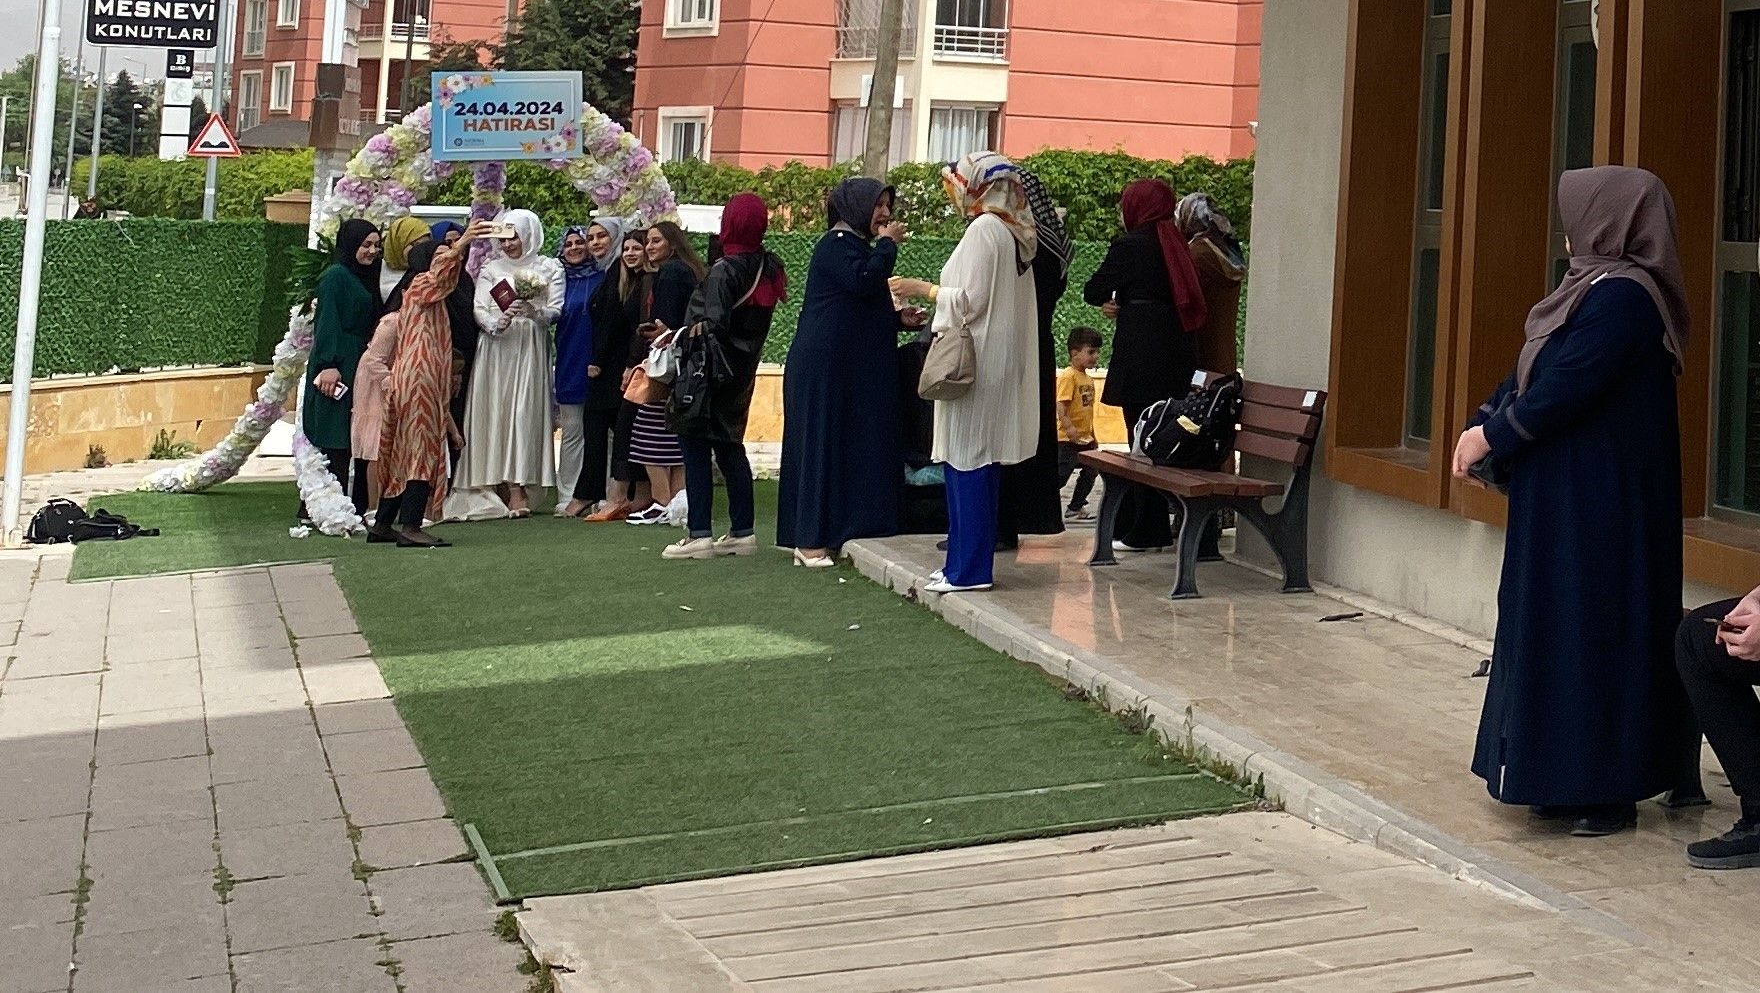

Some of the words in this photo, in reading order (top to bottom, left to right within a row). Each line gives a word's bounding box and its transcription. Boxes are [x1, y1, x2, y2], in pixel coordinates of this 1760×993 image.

[95, 23, 212, 41] KONUTLARI
[175, 54, 187, 65] B
[454, 101, 564, 116] 24.04.2024
[463, 117, 555, 132] HATIRASI
